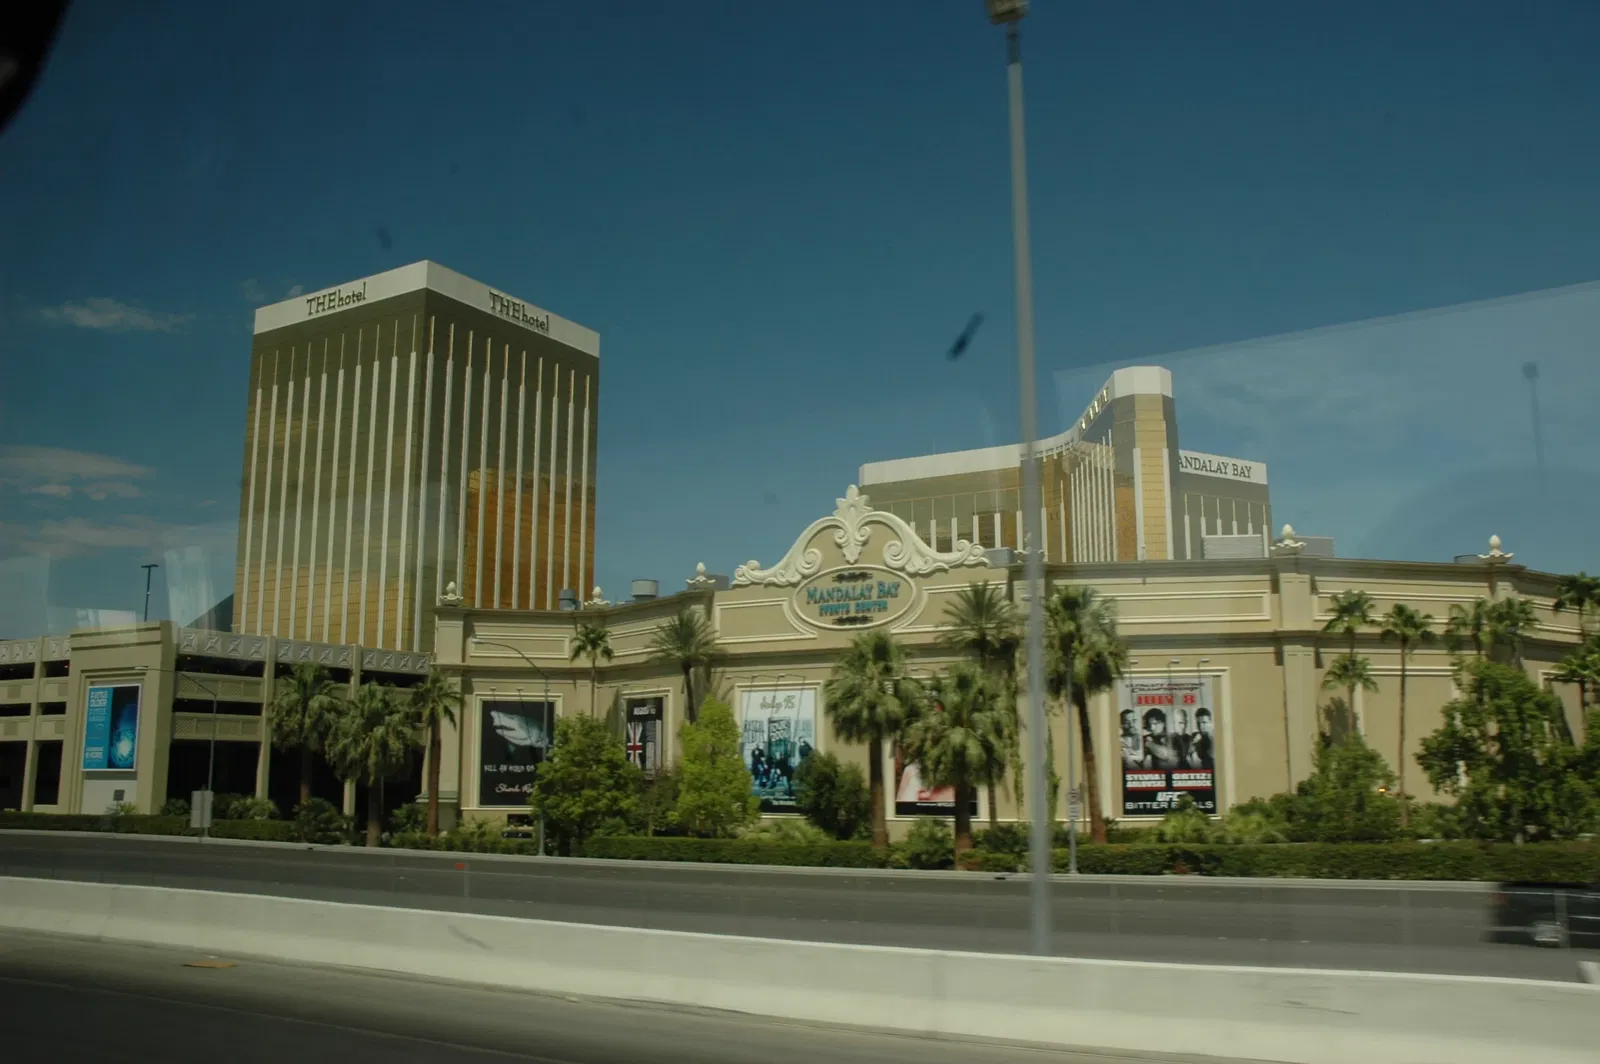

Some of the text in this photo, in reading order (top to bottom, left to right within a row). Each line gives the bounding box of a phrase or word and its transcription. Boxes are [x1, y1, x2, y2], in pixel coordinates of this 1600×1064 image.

[306, 281, 367, 316] THEhotel
[488, 287, 550, 332] THEhotel
[1178, 456, 1252, 479] ANDALAY BAY
[806, 580, 901, 605] MANDALAY BAY
[1125, 801, 1168, 810] BITTER
[1156, 791, 1187, 802] UFC
